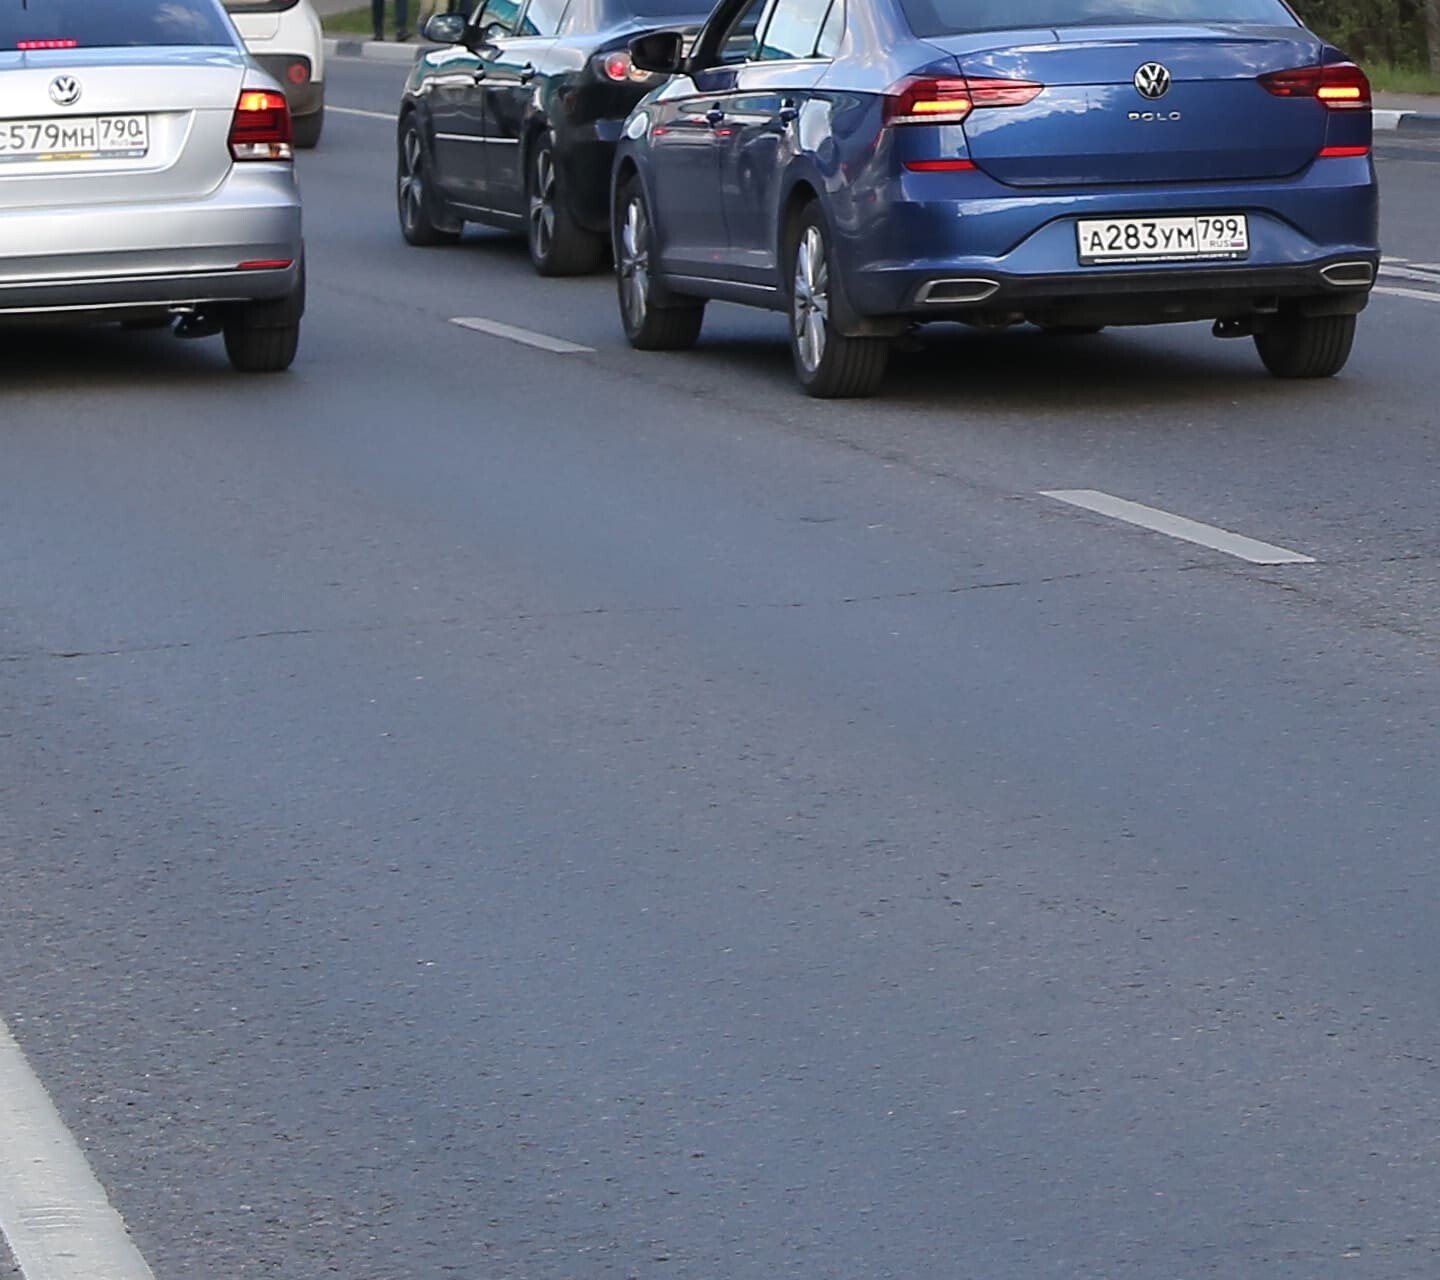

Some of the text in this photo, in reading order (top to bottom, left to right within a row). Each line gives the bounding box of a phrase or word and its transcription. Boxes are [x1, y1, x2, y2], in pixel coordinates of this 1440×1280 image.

[1128, 111, 1181, 121] POLO
[100, 119, 140, 138] 790
[1089, 218, 1238, 252] А283УМ 799
[1209, 239, 1231, 248] RUS
